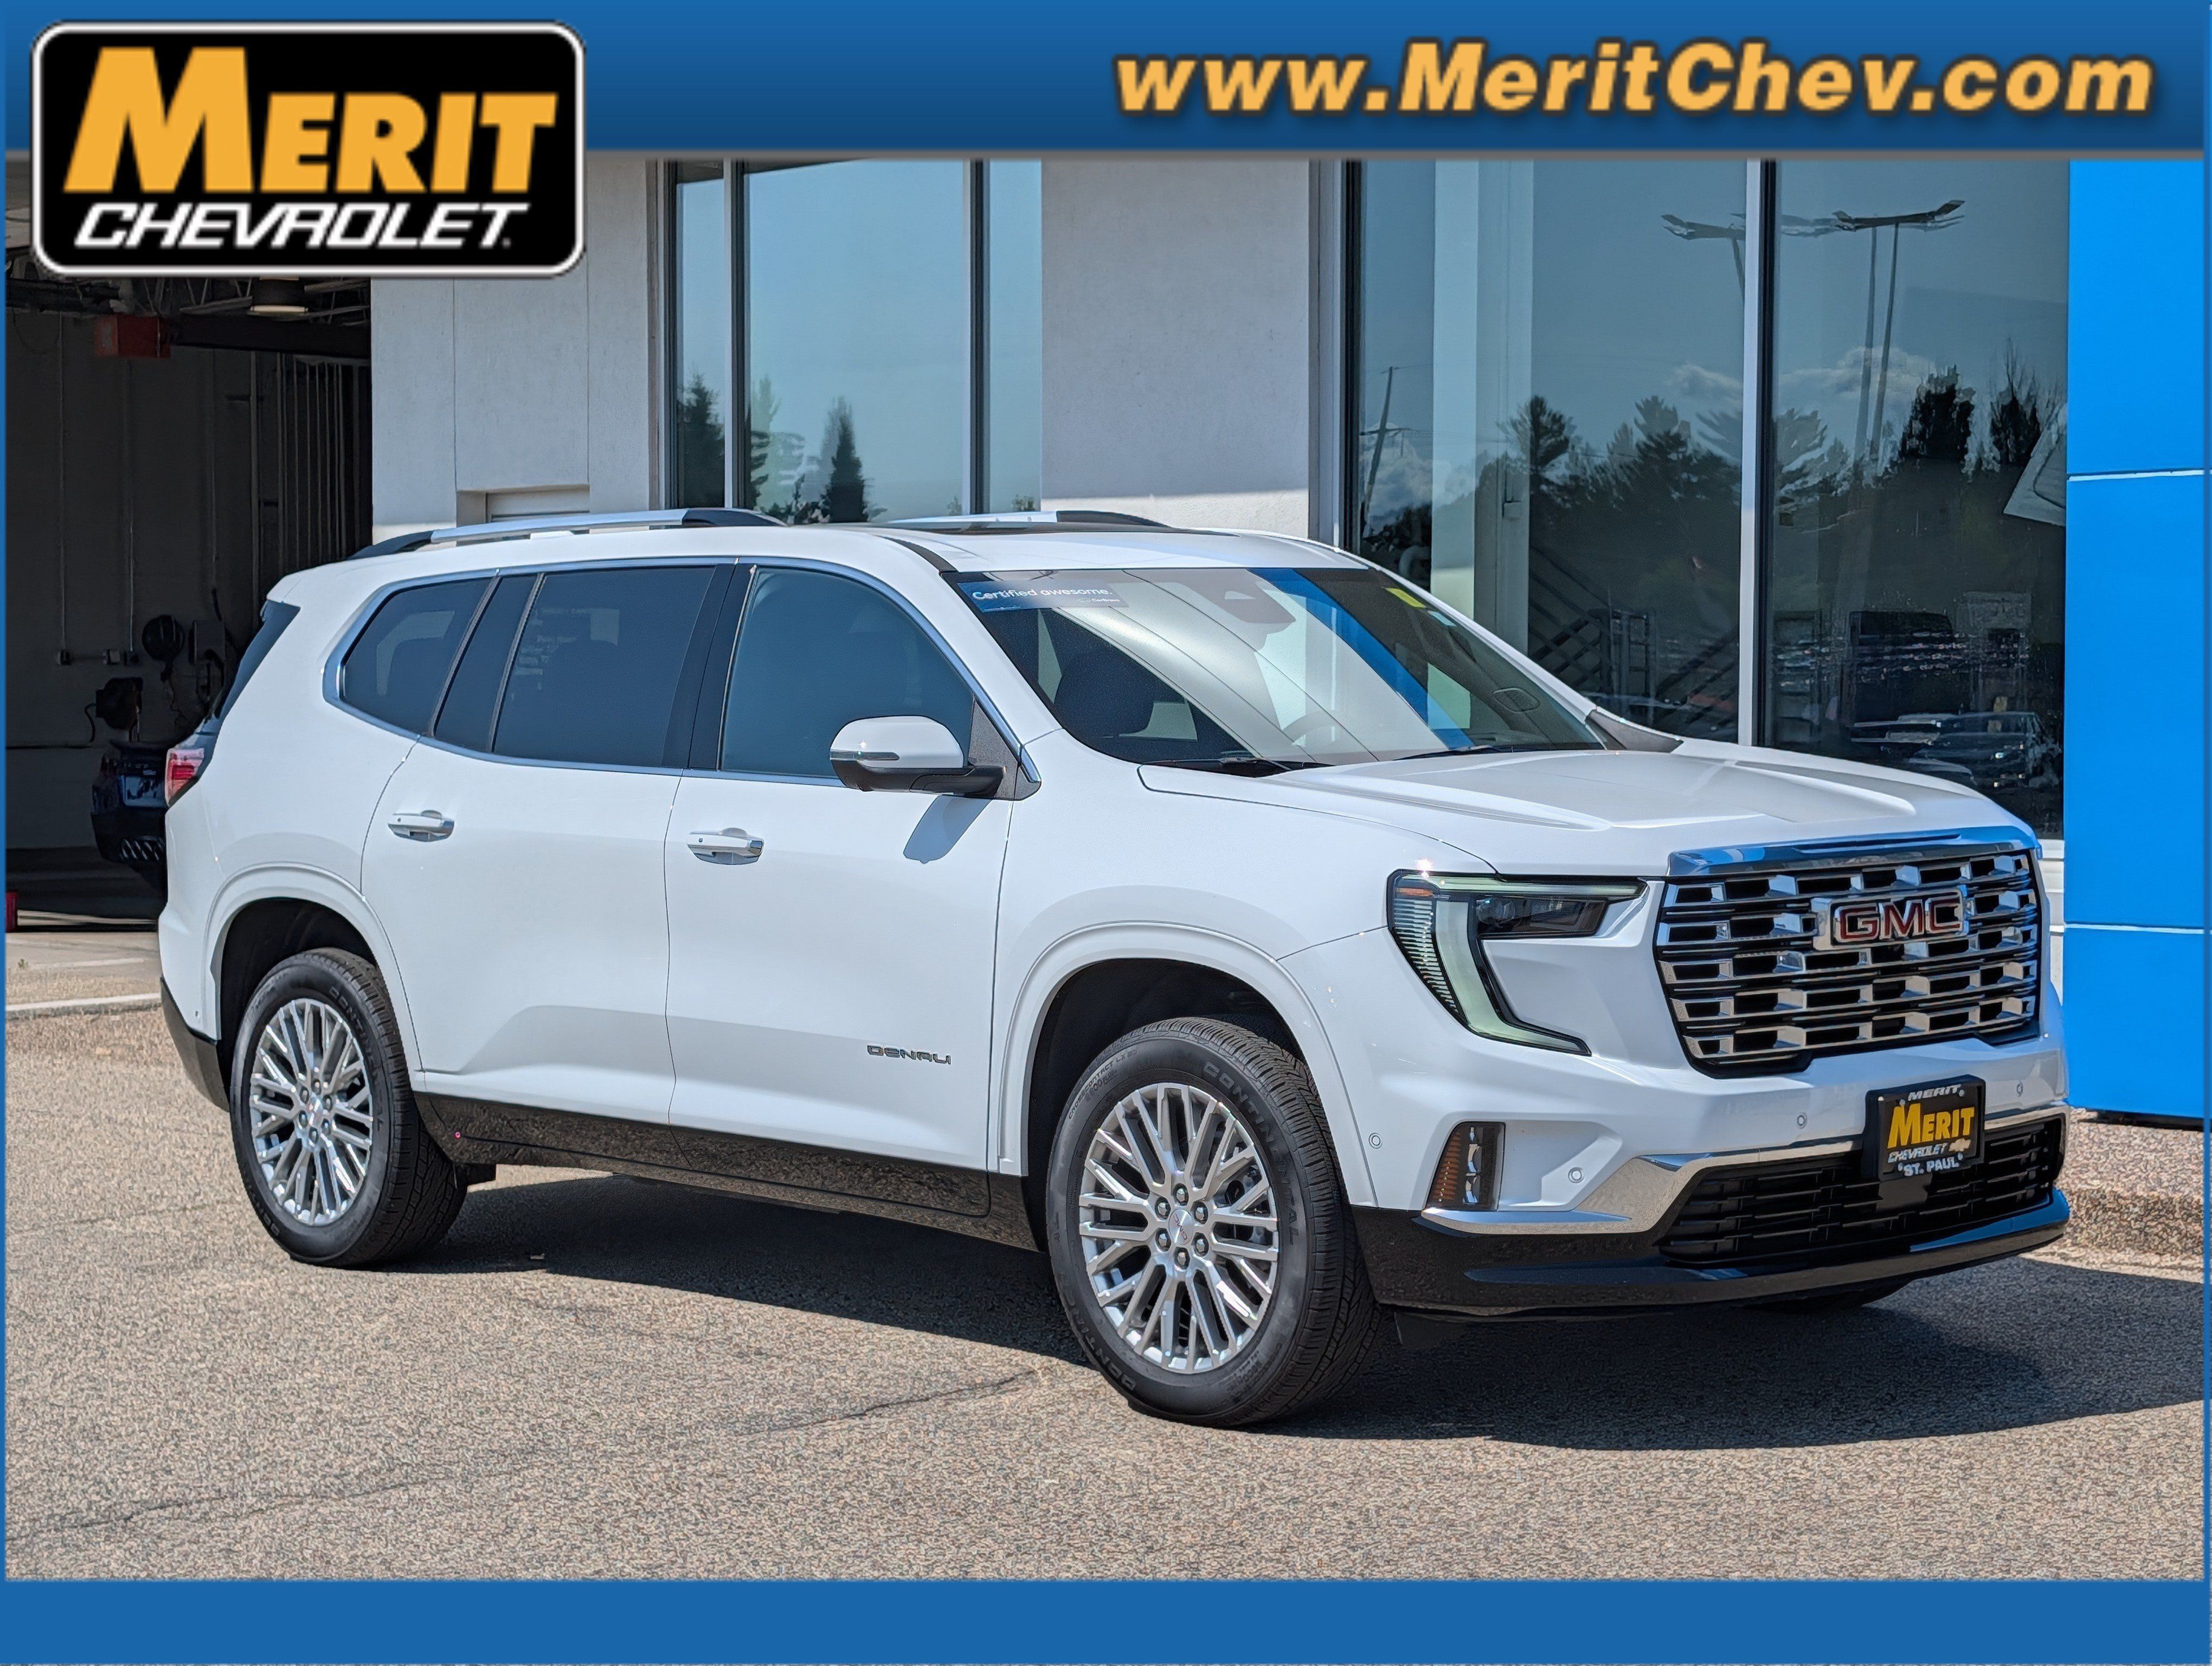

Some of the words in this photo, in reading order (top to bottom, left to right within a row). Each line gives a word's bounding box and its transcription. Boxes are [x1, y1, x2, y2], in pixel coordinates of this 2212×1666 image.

[972, 588, 1038, 600] Certified
[1040, 587, 1113, 596] awesome.
[1833, 896, 1963, 943] GMC
[867, 1045, 951, 1065] DENALI
[1907, 1084, 1962, 1101] MERIT
[1887, 1102, 1975, 1149] MERIT
[1887, 1142, 1948, 1164] CHEVROLET
[1903, 1163, 1925, 1176] ST.
[1926, 1156, 1960, 1172] PAUL
